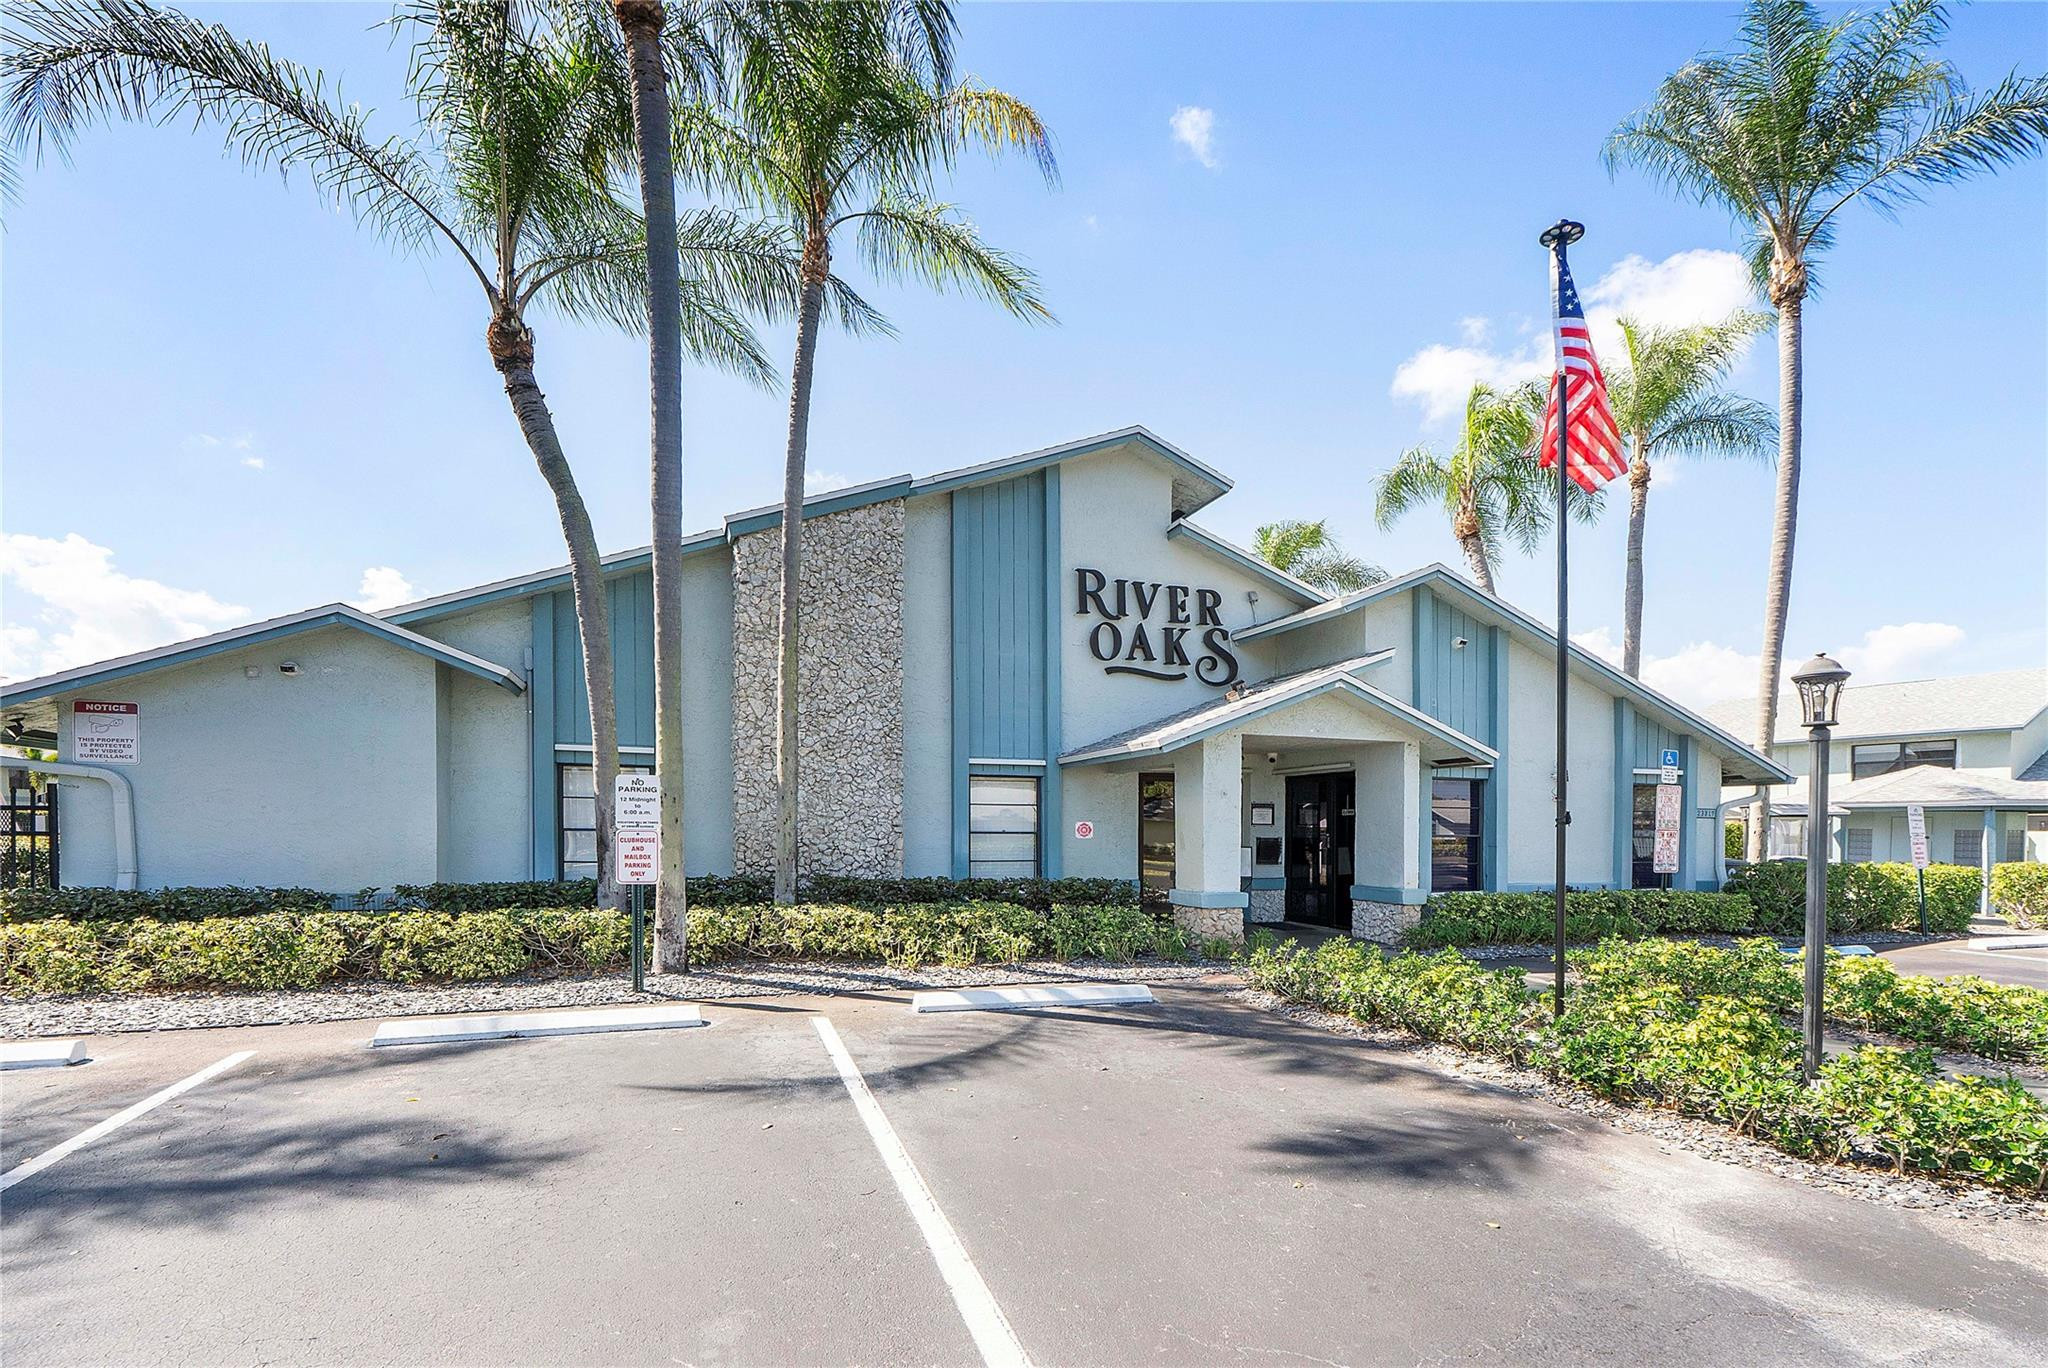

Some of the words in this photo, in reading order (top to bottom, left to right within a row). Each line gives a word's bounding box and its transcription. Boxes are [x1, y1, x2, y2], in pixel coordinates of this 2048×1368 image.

[1075, 568, 1224, 626] RIVER
[1089, 621, 1238, 687] OAKS
[85, 703, 127, 712] NOTICE
